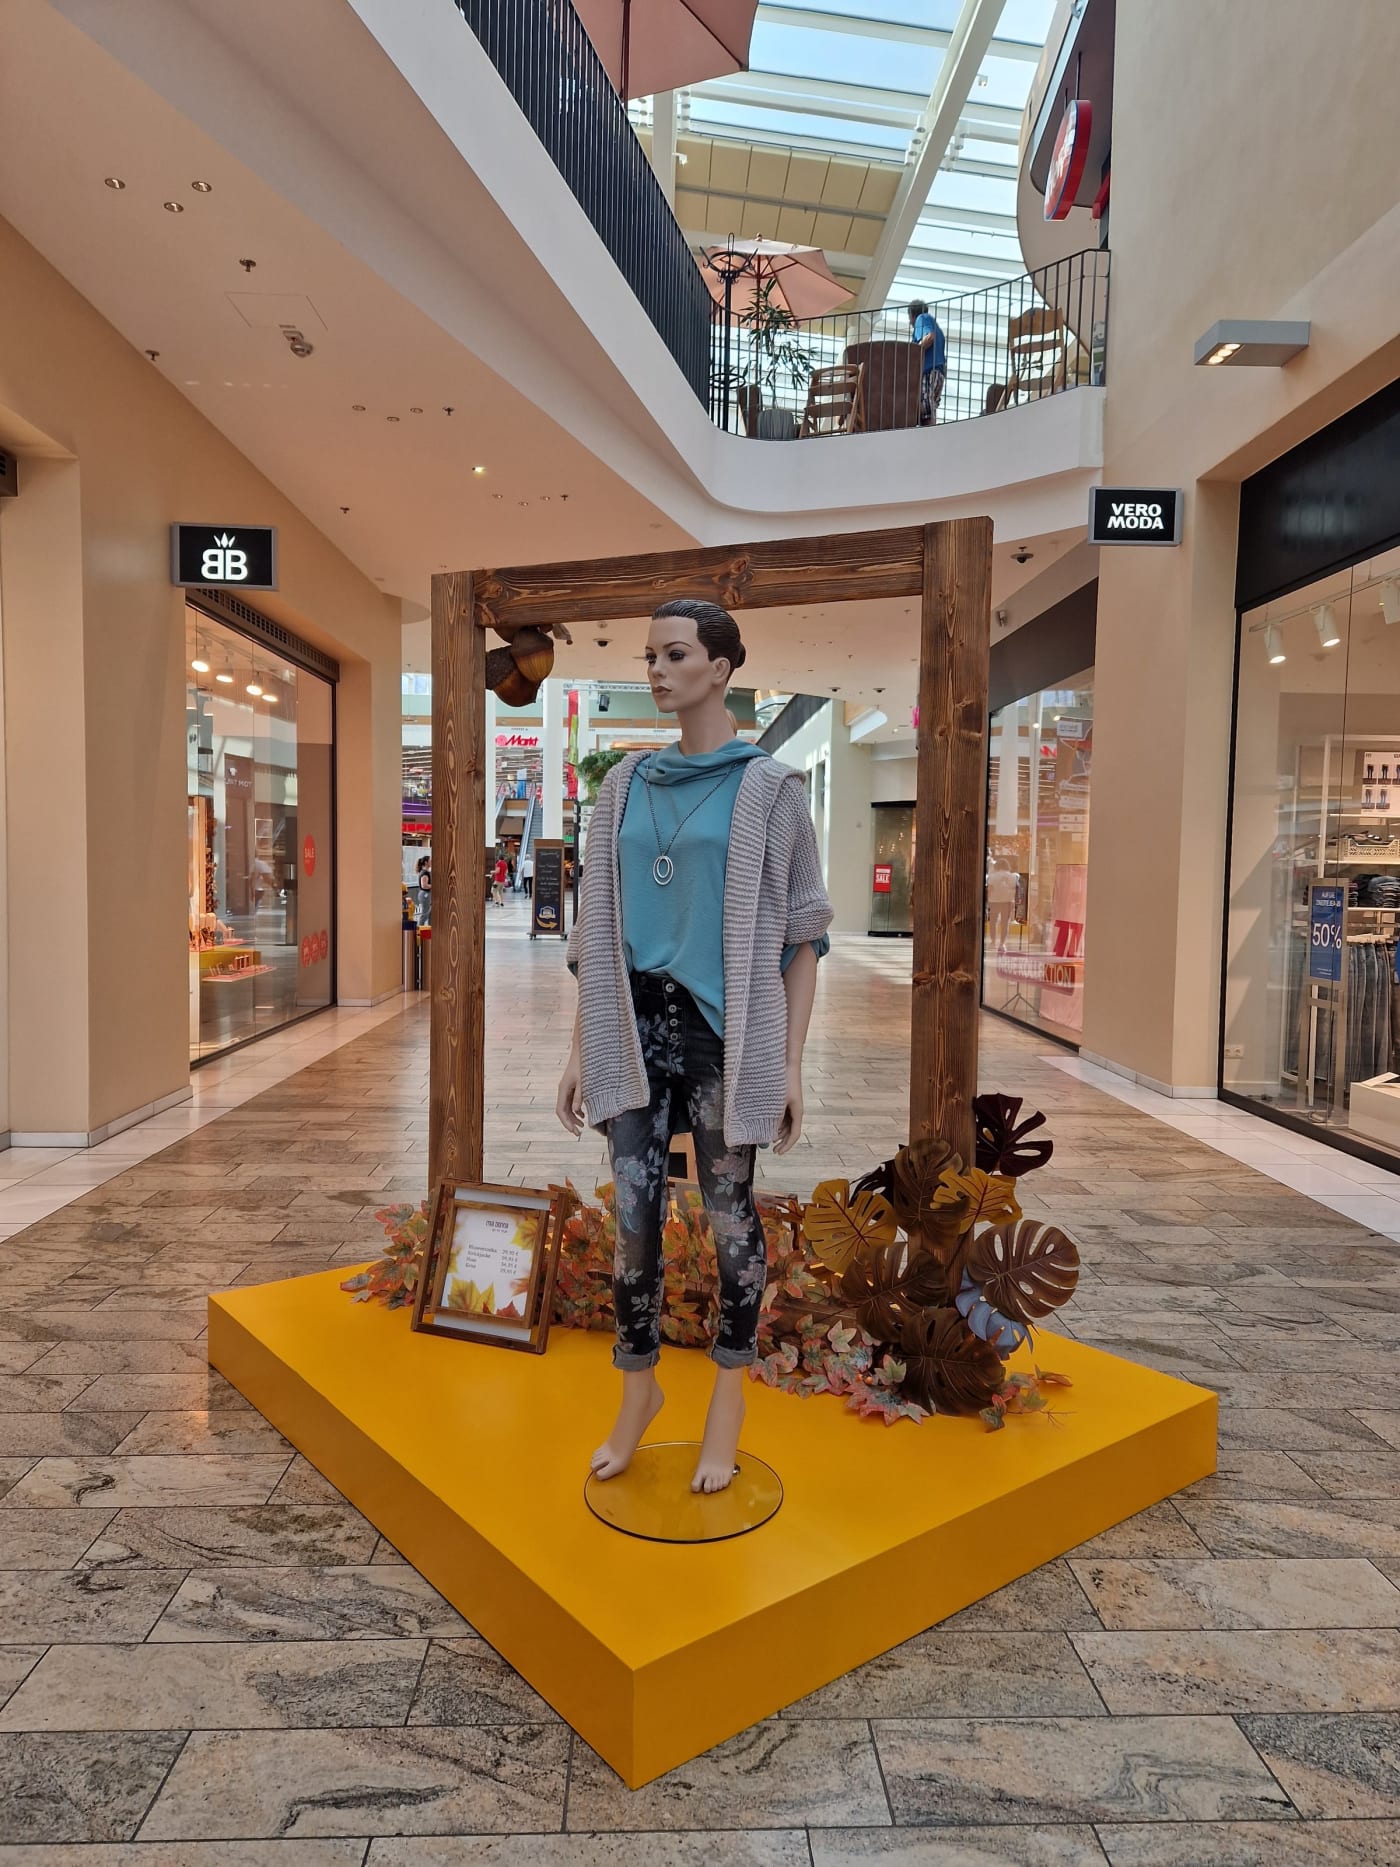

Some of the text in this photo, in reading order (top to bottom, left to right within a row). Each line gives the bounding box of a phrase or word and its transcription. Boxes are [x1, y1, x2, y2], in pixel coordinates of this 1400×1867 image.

[1111, 503, 1162, 517] VERO
[1107, 516, 1165, 529] MODA
[505, 734, 538, 746] Markt
[304, 847, 315, 858] SALE
[875, 874, 890, 884] SALE
[1312, 922, 1342, 949] 50%
